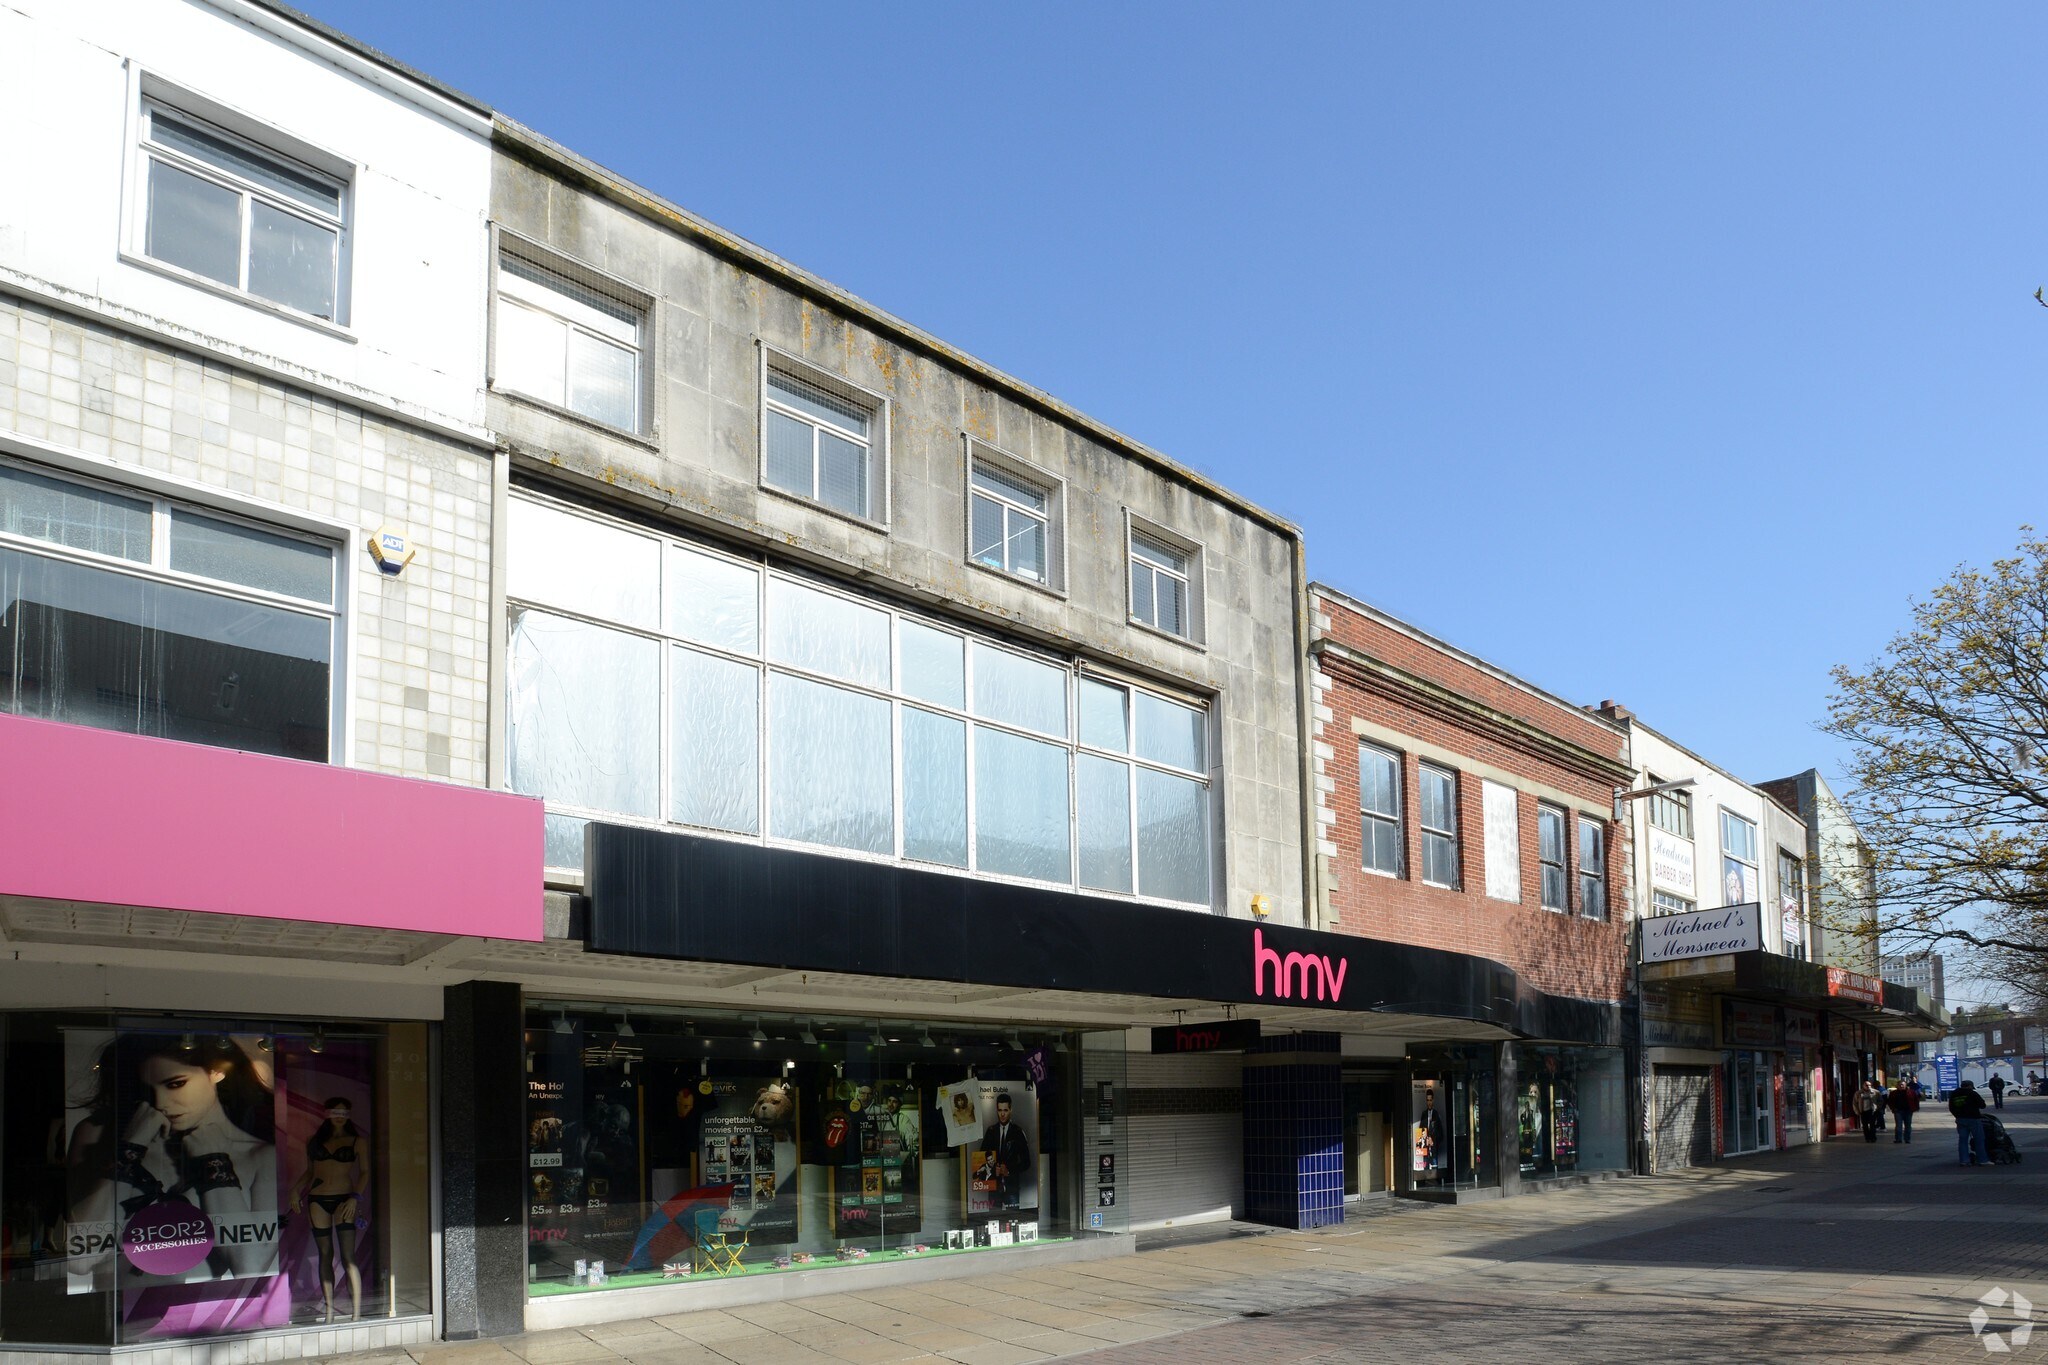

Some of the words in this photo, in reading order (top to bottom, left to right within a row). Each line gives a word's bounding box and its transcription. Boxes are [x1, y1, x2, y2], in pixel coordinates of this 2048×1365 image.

[383, 537, 404, 550] ADT
[1654, 861, 1677, 883] BARBER
[1678, 869, 1692, 888] SHOP
[1653, 911, 1746, 937] Michael's
[1653, 938, 1748, 957] Menswear
[1254, 927, 1348, 1003] hmv
[1176, 1029, 1222, 1051] hmv
[528, 1081, 546, 1092] The
[528, 1092, 538, 1100] An
[704, 1116, 756, 1125] unforgettable
[733, 1126, 752, 1134] from
[713, 1138, 725, 1146] ted
[533, 1158, 560, 1166] £12.99
[531, 1205, 553, 1214] £5.99
[559, 1204, 581, 1213] £3.99
[587, 1199, 609, 1209] £3.99
[972, 1198, 996, 1210] hmv
[841, 1208, 869, 1220] hmv
[219, 1222, 277, 1244] NEW
[529, 1225, 568, 1241] hmv
[132, 1236, 207, 1253] ACCESSORIES
